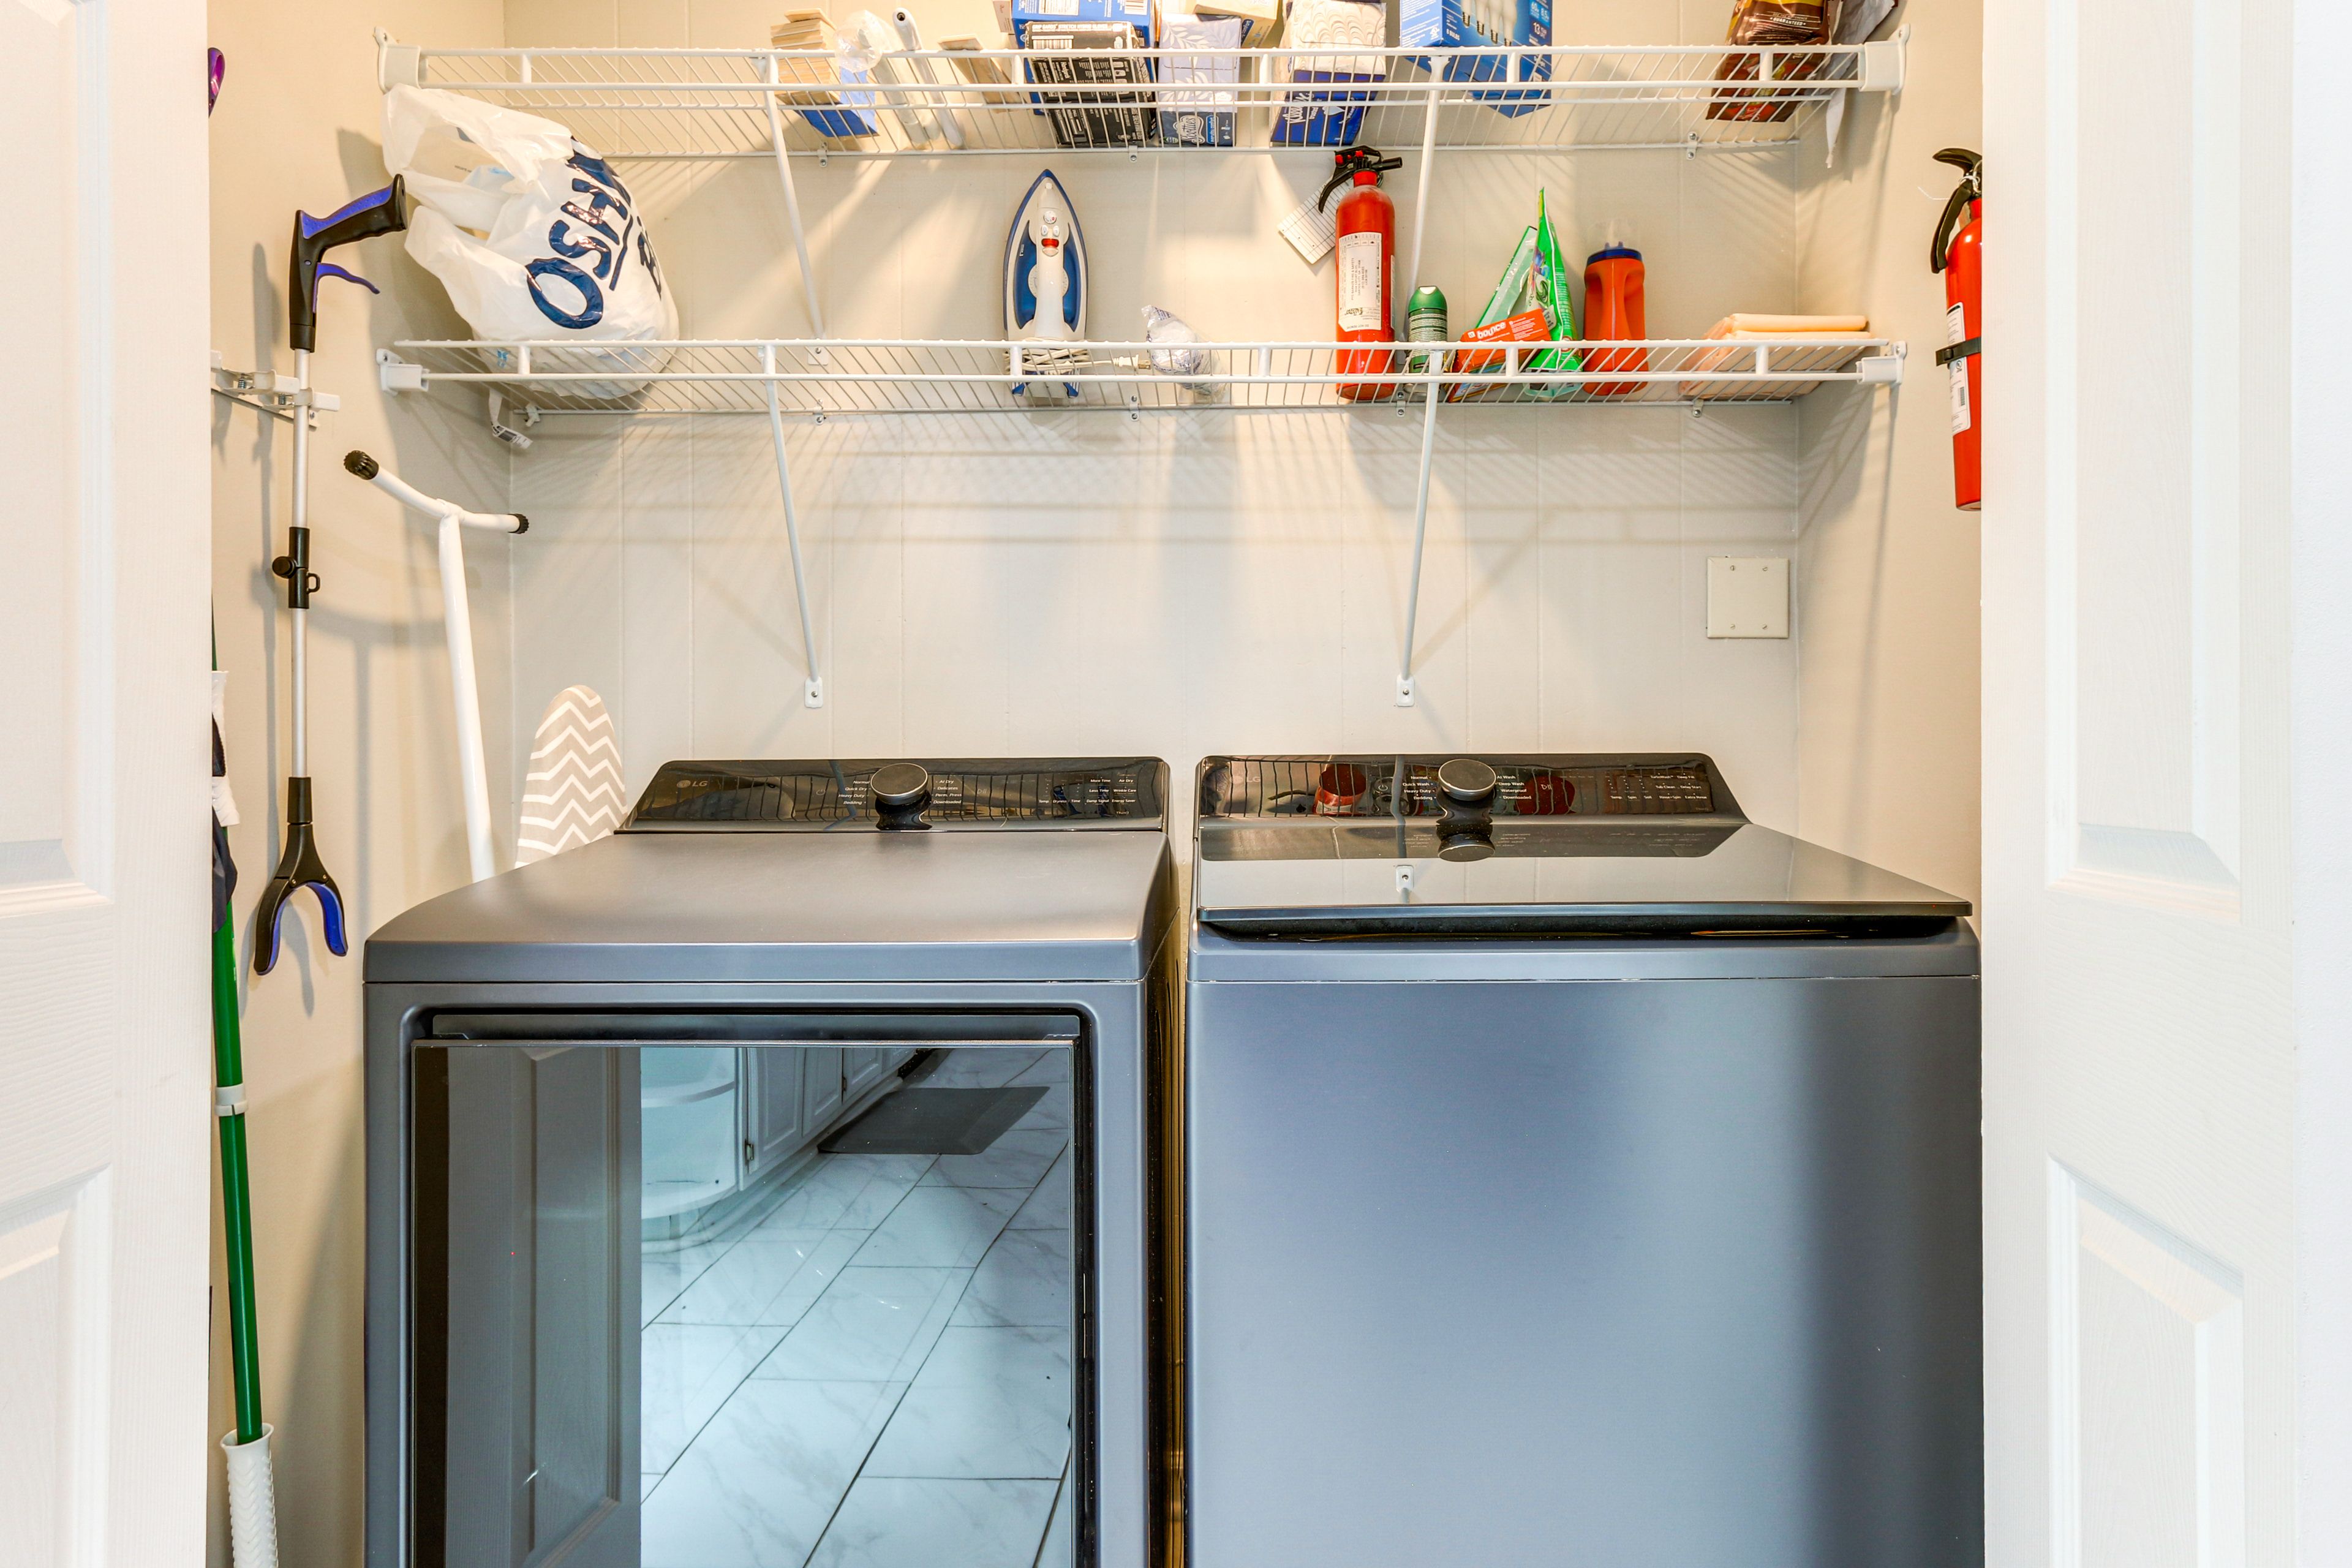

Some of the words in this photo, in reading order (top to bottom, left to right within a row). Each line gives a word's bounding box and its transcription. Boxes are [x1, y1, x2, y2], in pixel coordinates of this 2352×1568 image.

[1773, 17, 1803, 26] GUARANTEED
[1283, 92, 1313, 124] Kleex
[1180, 117, 1199, 143] Scotties
[1476, 322, 1507, 339] bounce
